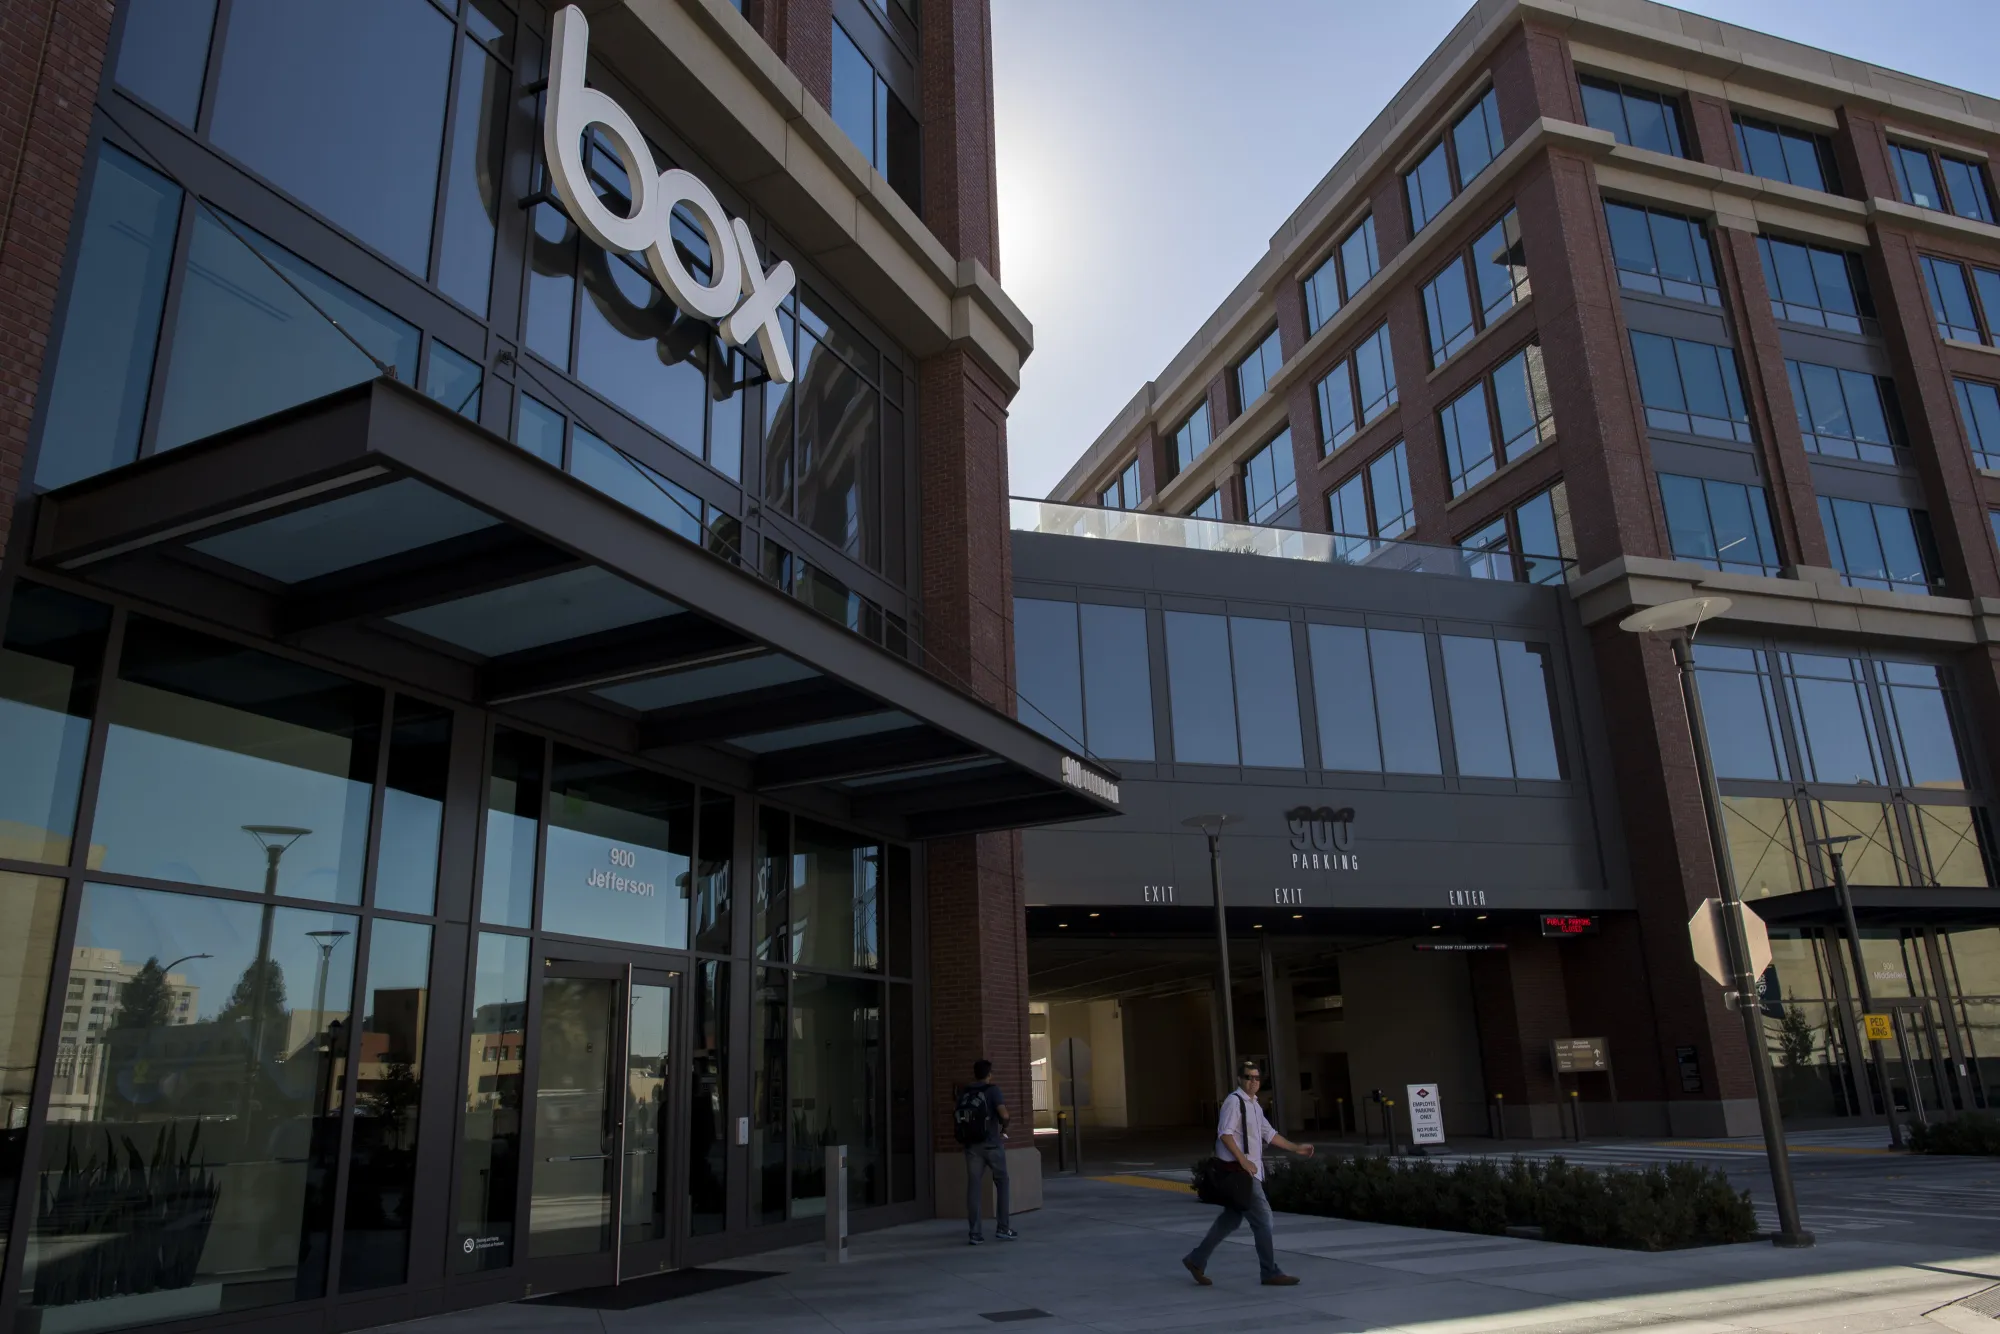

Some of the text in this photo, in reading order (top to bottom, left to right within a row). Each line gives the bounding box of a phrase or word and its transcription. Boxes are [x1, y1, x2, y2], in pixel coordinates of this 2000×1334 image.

[544, 4, 796, 384] box
[1062, 756, 1081, 788] 900
[611, 847, 635, 868] 900
[1292, 853, 1358, 870] PARKING
[588, 868, 654, 896] Jefferson
[1144, 885, 1173, 902] EXIT
[1275, 887, 1302, 904] EXIT
[1449, 890, 1486, 906] ENTER
[1546, 917, 1592, 926] PUBLIC PARKING
[1562, 925, 1583, 933] CLOSED
[1870, 1017, 1884, 1026] PED
[1871, 1027, 1888, 1036] XING
